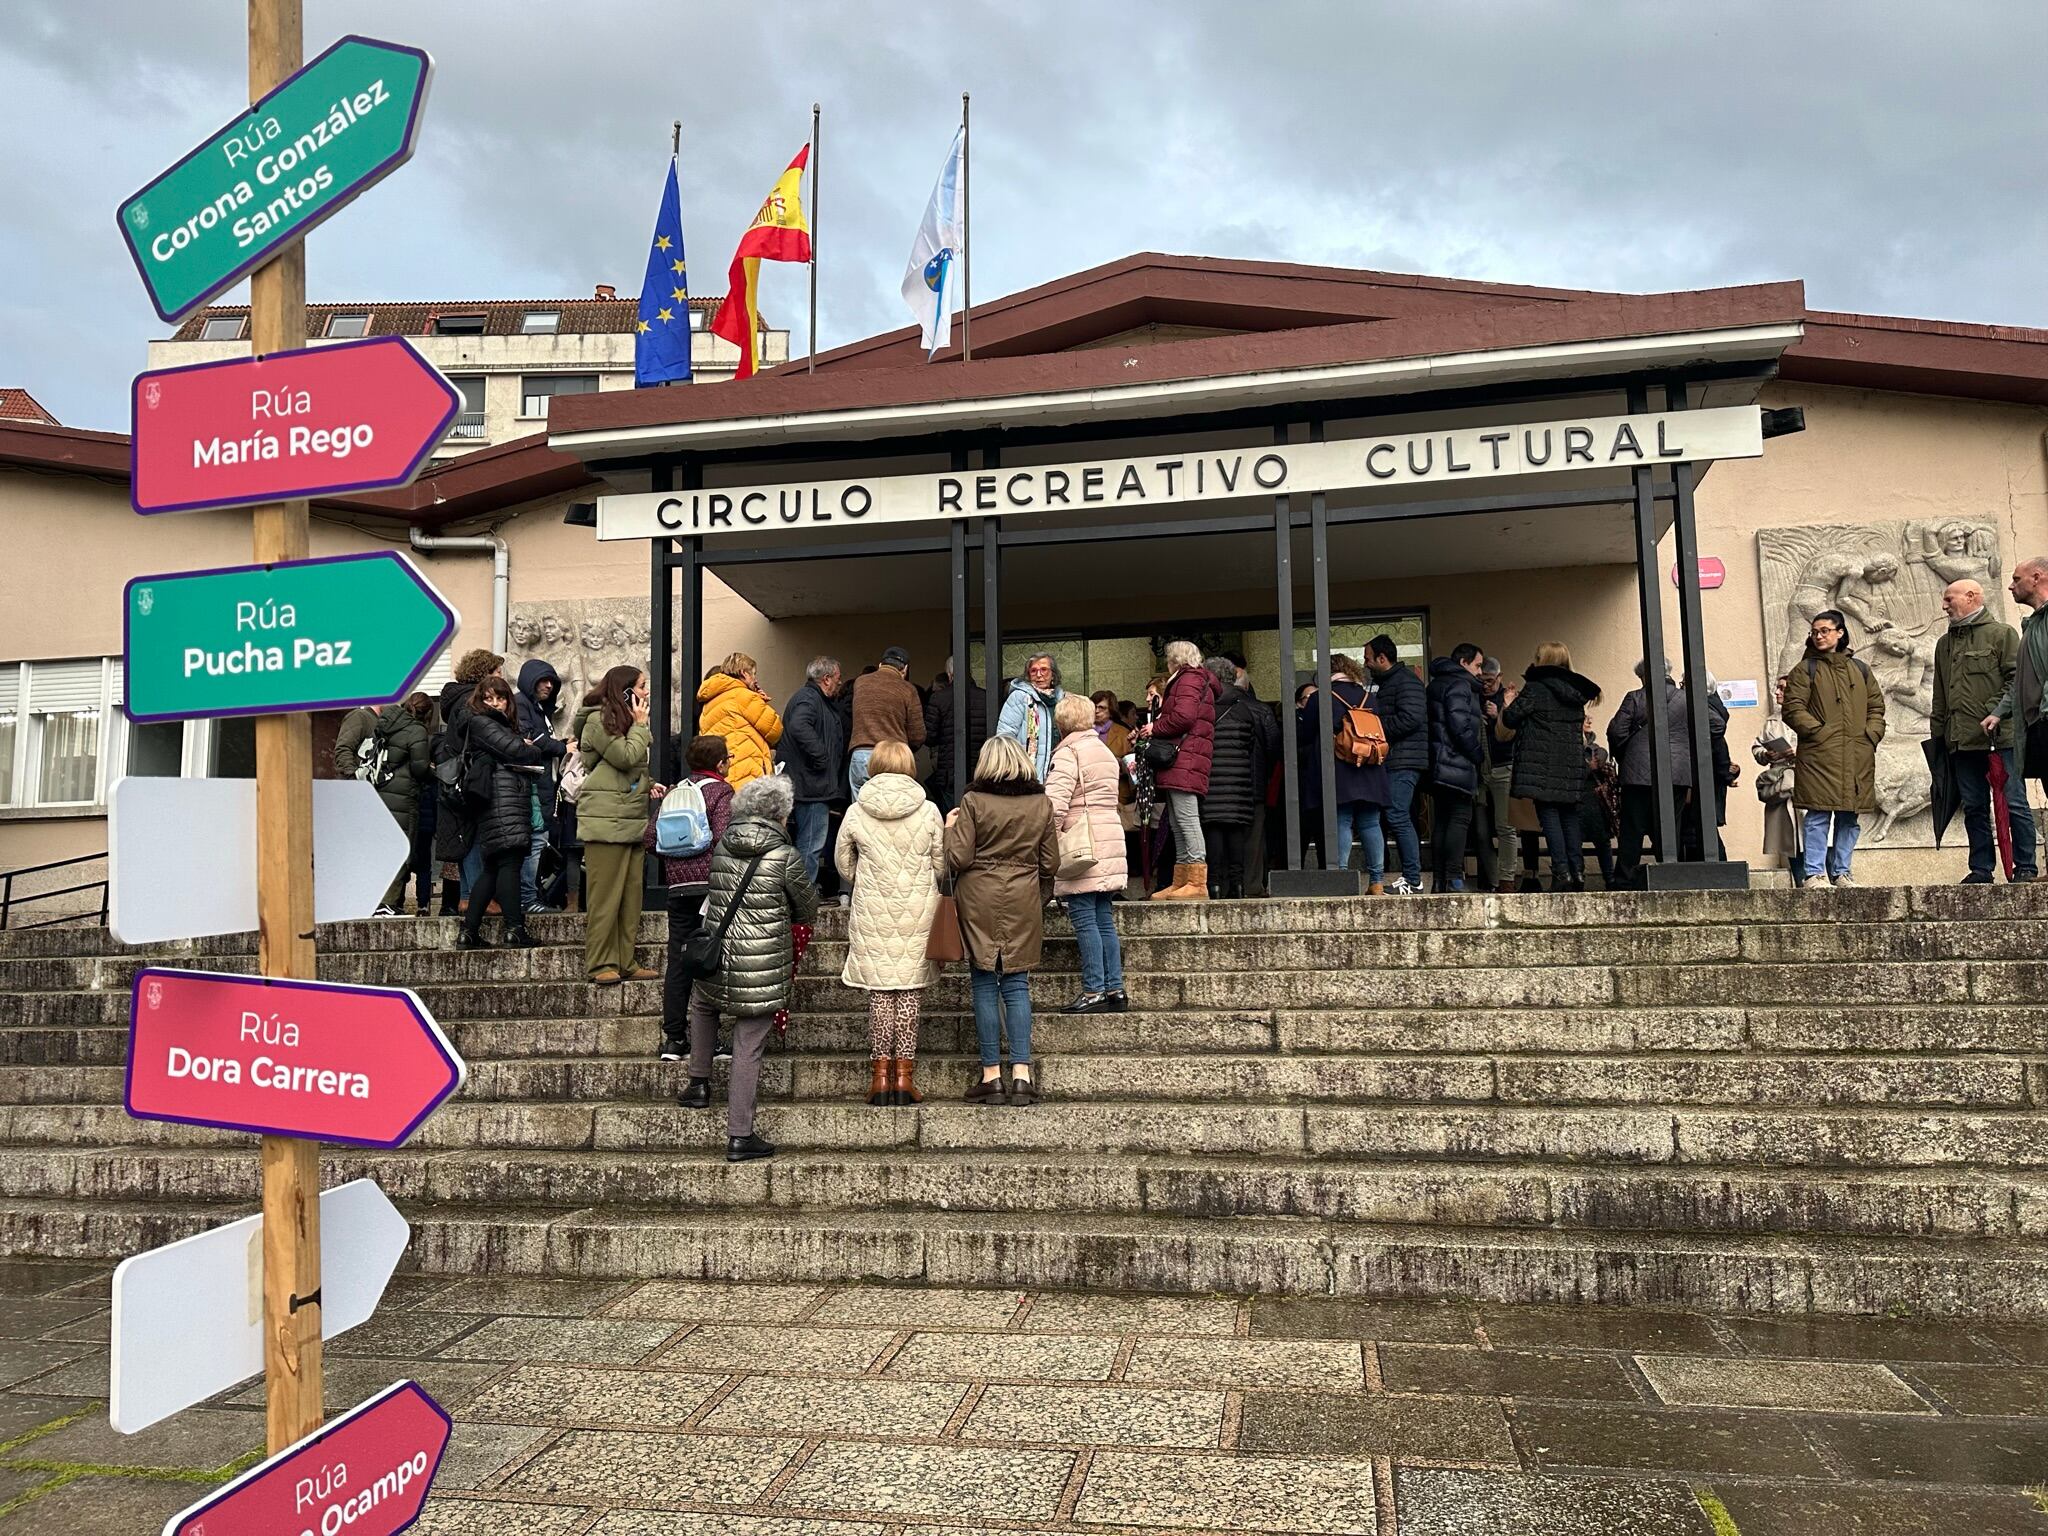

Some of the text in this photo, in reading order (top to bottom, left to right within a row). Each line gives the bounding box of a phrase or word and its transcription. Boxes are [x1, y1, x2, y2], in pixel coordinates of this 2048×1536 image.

[222, 117, 281, 167] Rúa
[152, 79, 390, 261] Corona González
[232, 165, 333, 248] Santos
[251, 386, 311, 420] Rúa
[193, 424, 373, 468] María Rego
[656, 420, 1684, 530] CIRCULO RECREATIVO CULTURAL
[236, 598, 296, 631] Rúa
[184, 639, 352, 677] Pucha Paz
[240, 1012, 300, 1047] Rúa
[167, 1047, 369, 1099] Dora Carrera
[296, 1462, 347, 1514] Rúa
[321, 1451, 427, 1536] Ocampo
